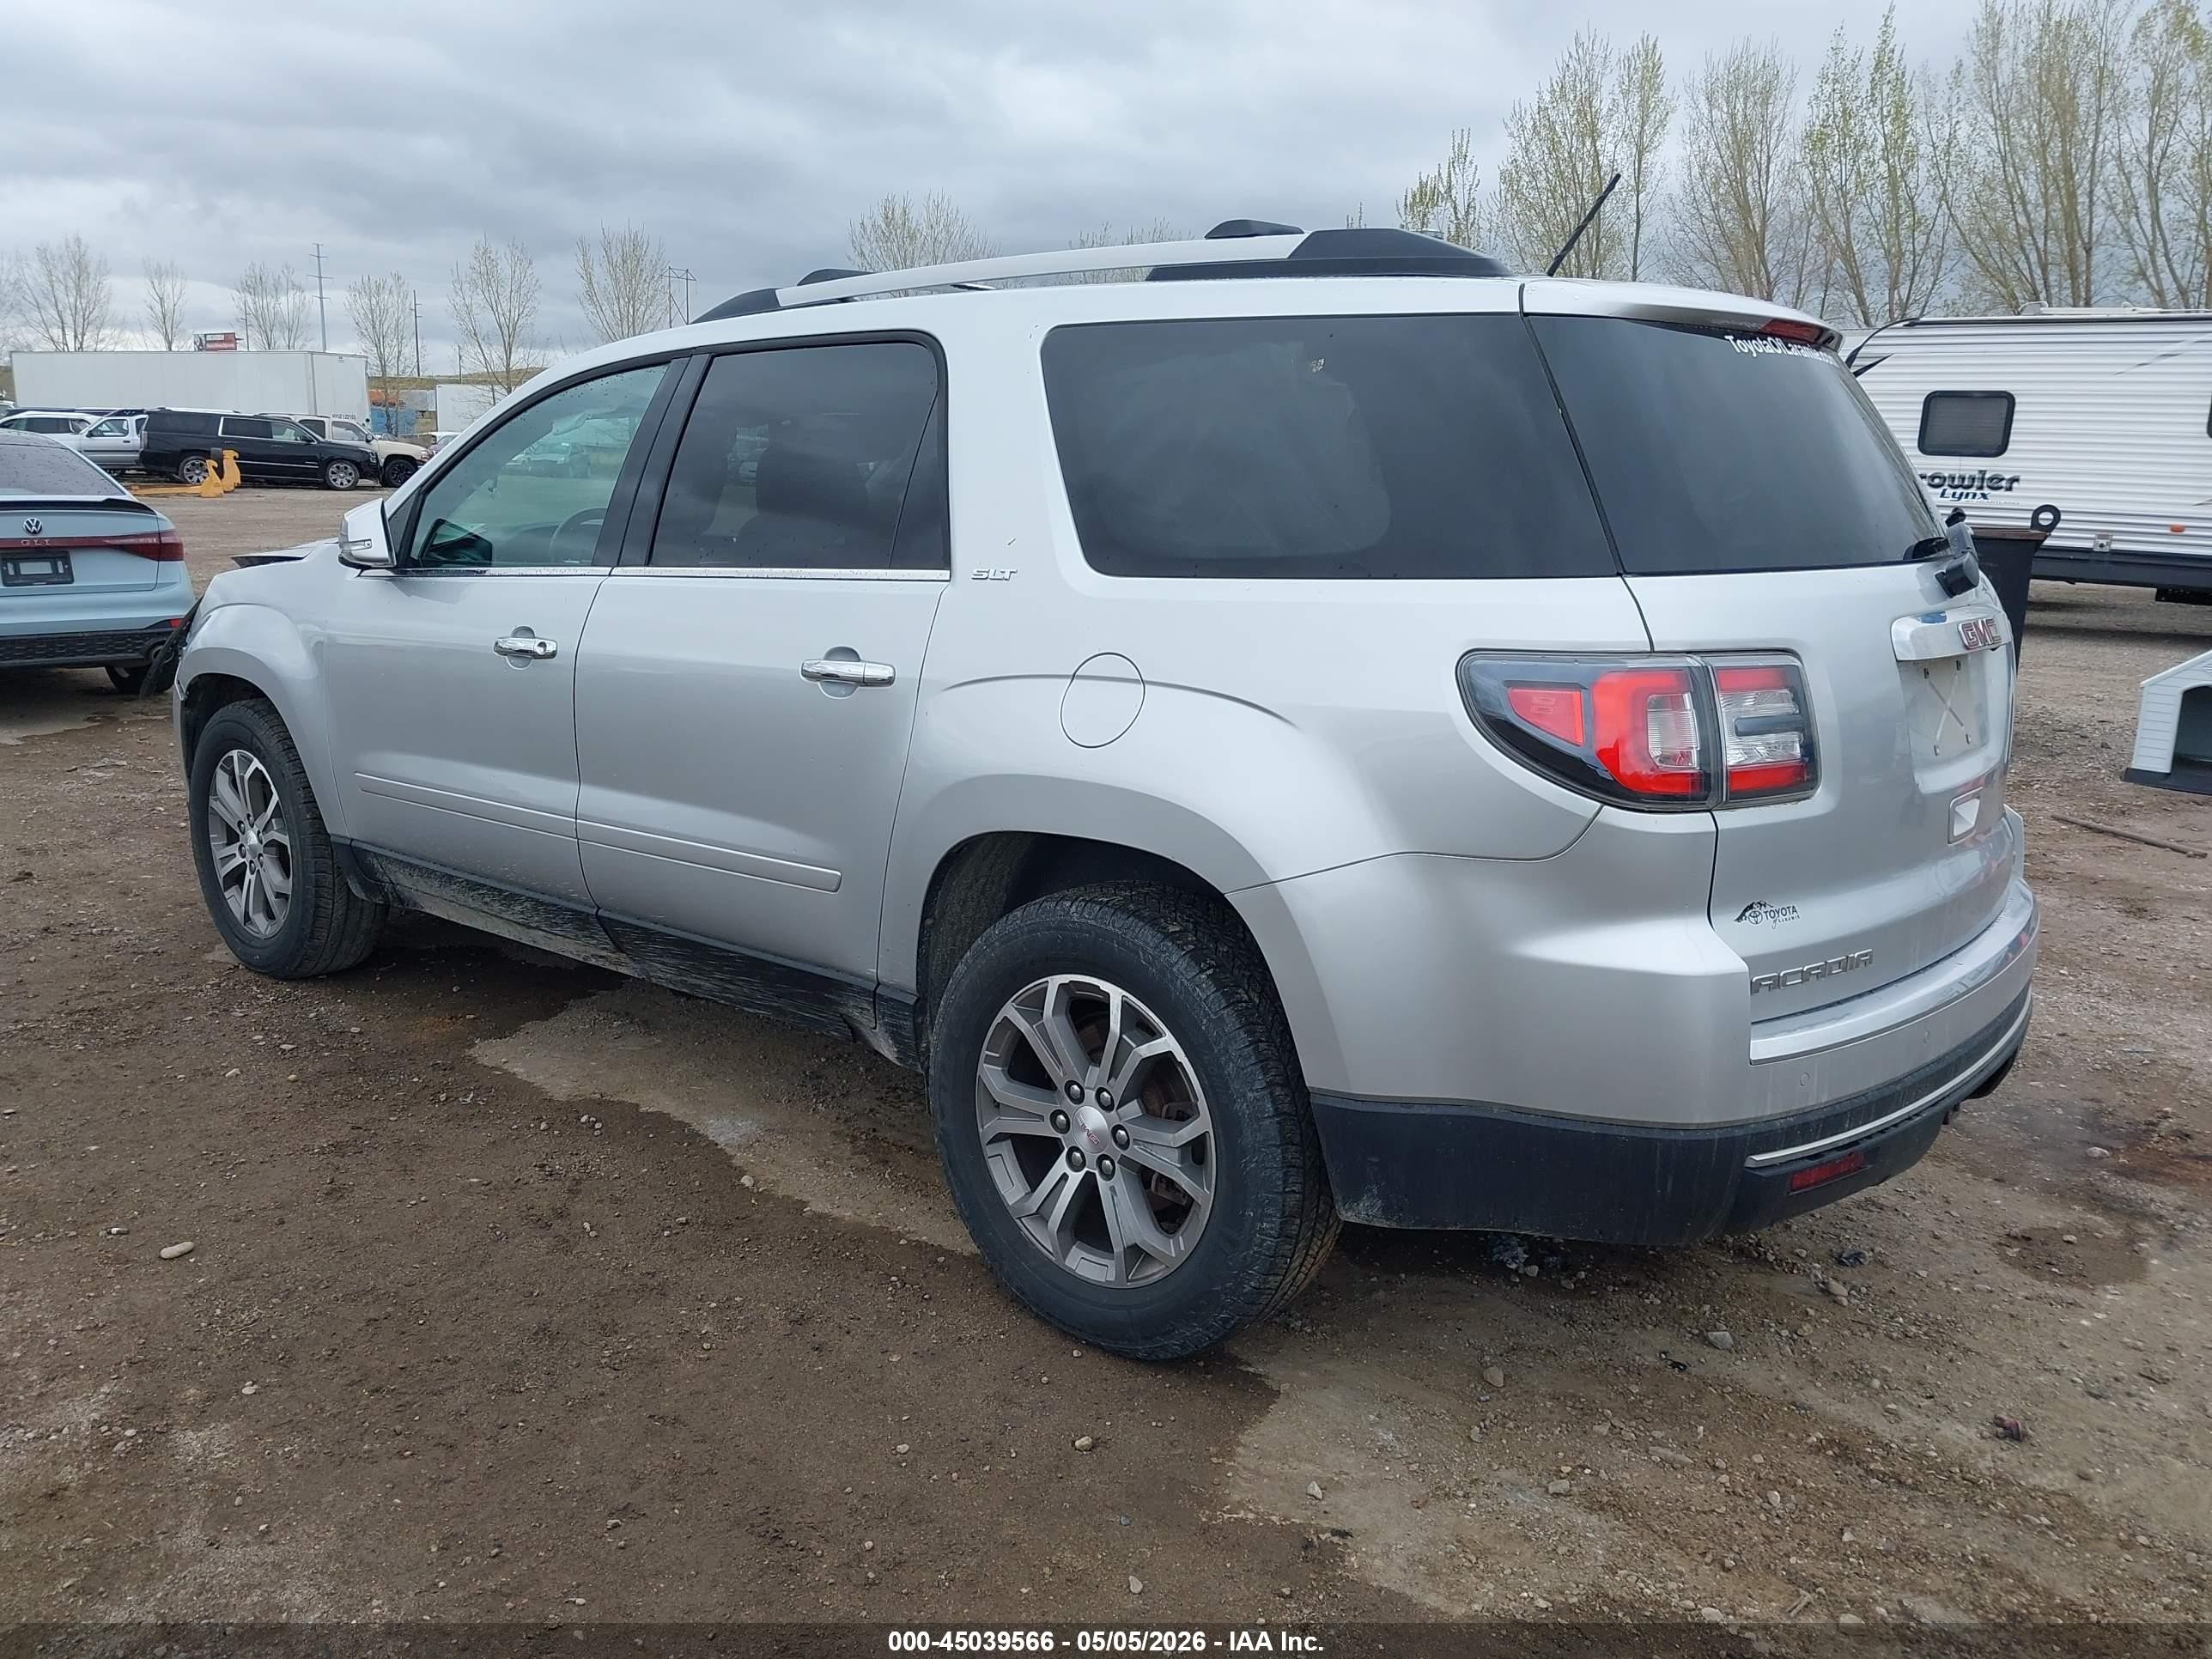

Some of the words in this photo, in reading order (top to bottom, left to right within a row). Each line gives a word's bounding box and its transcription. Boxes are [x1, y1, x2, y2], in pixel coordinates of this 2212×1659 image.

[1918, 470, 2021, 492] rowler
[1939, 488, 1990, 501] Lynx
[970, 568, 1018, 581] SLT
[1958, 617, 2003, 650] GMC
[1763, 905, 1799, 921] TOYOTA
[1750, 948, 1875, 996] ACADIA
